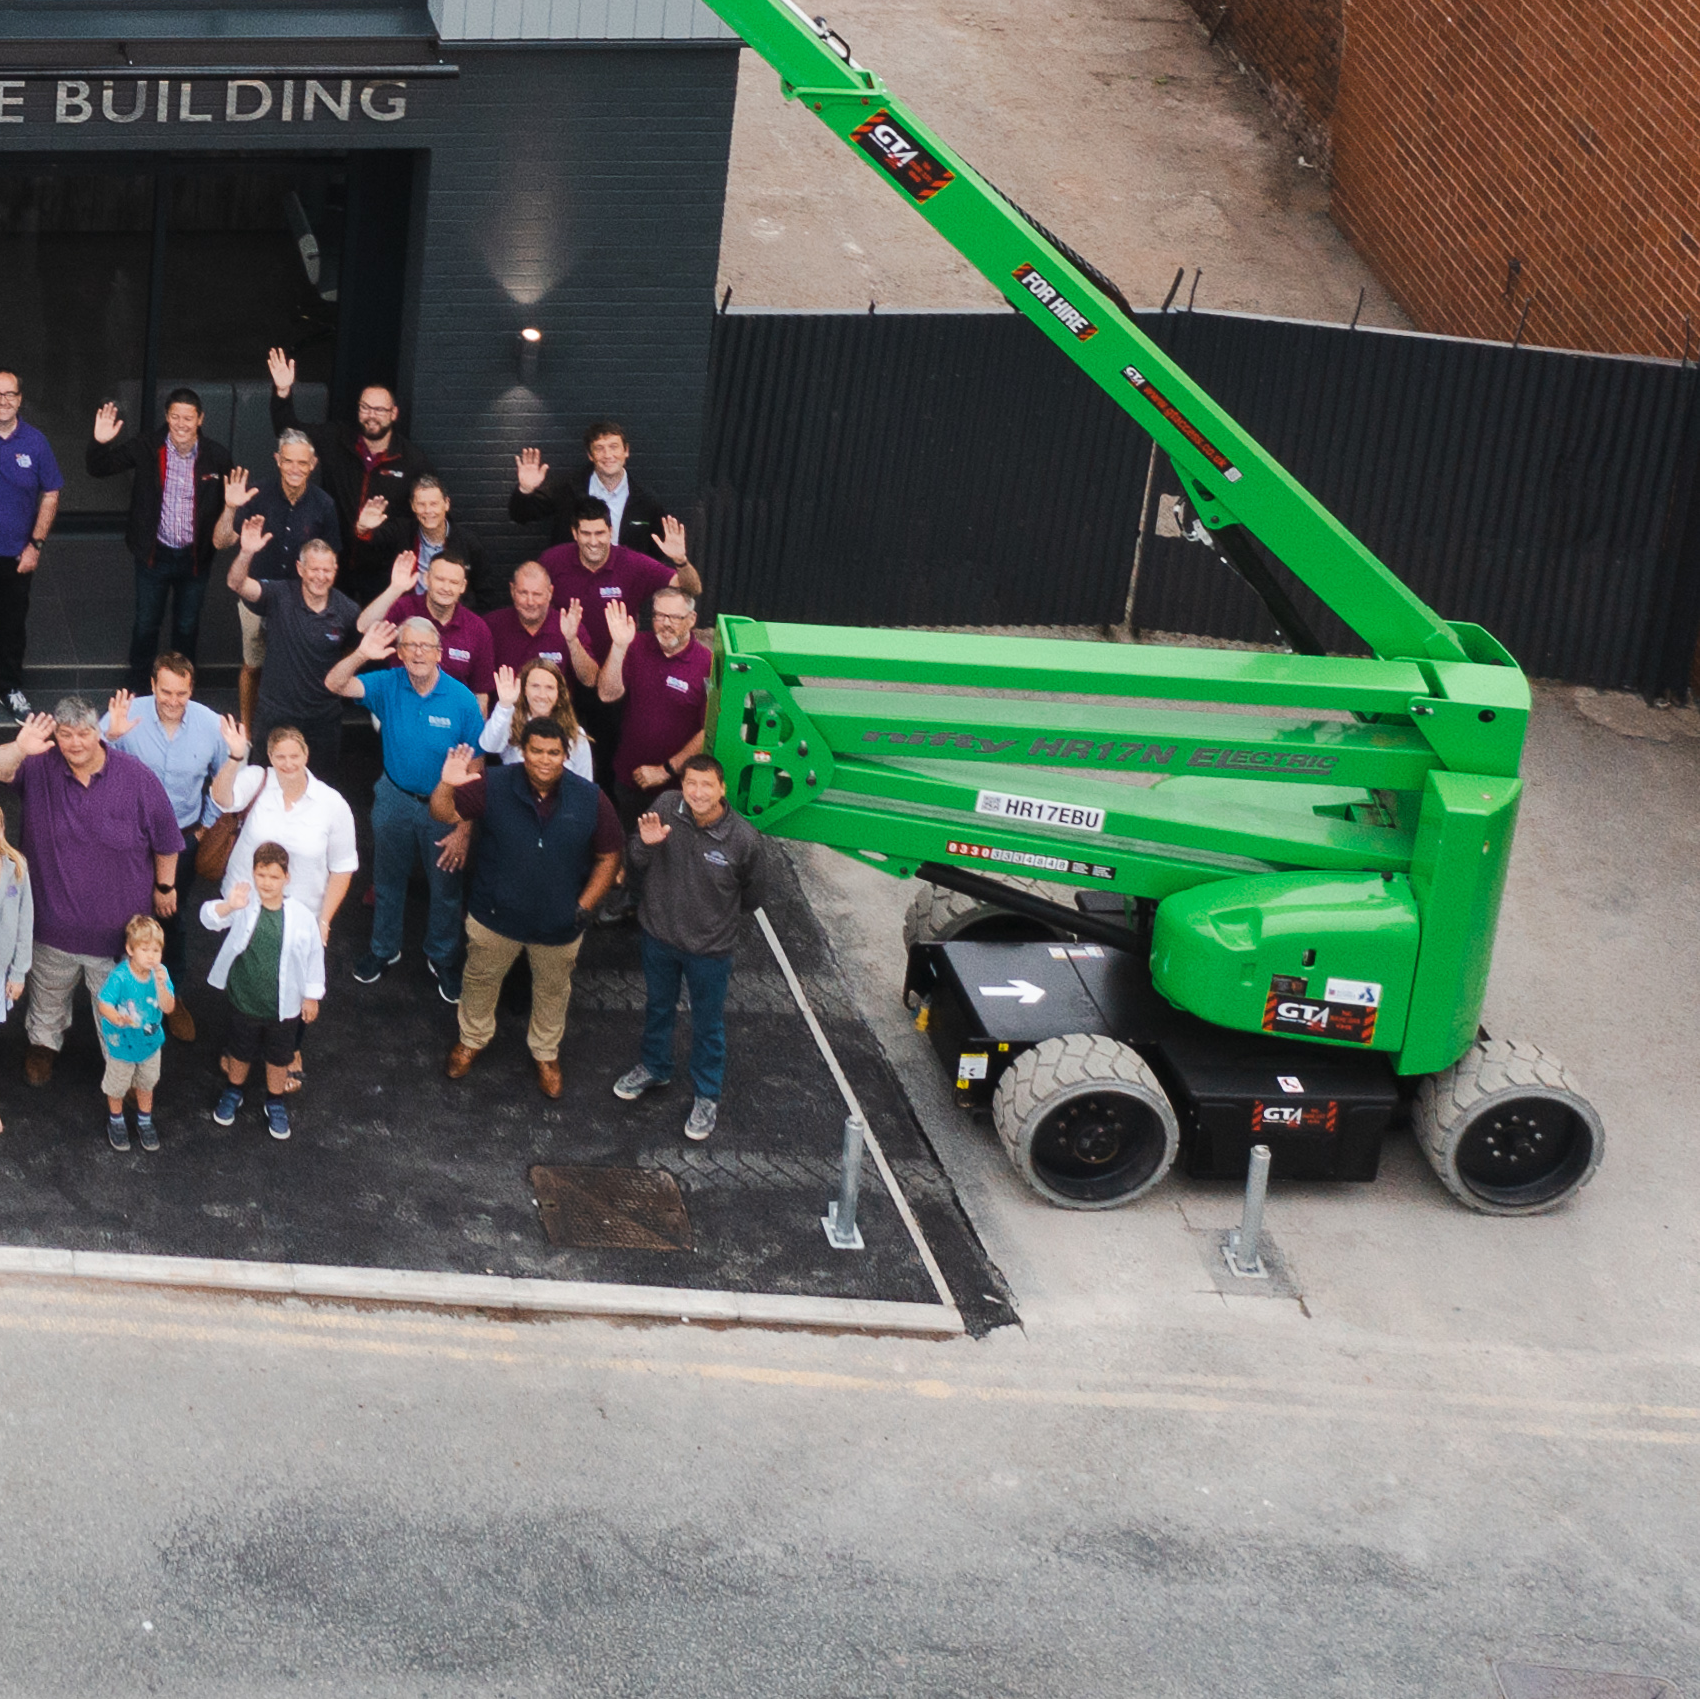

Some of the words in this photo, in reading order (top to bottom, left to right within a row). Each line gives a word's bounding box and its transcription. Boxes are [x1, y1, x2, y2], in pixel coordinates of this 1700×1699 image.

[55, 79, 407, 124] BUILDING
[874, 124, 919, 167] GTA
[1021, 271, 1057, 304] FOR
[1049, 297, 1089, 334] HIRE
[862, 730, 1019, 754] nifty
[1028, 737, 1179, 766] HR17N
[1005, 798, 1099, 828] HR17EBU
[1277, 1002, 1330, 1028] GTA
[1263, 1107, 1303, 1124] GTA
